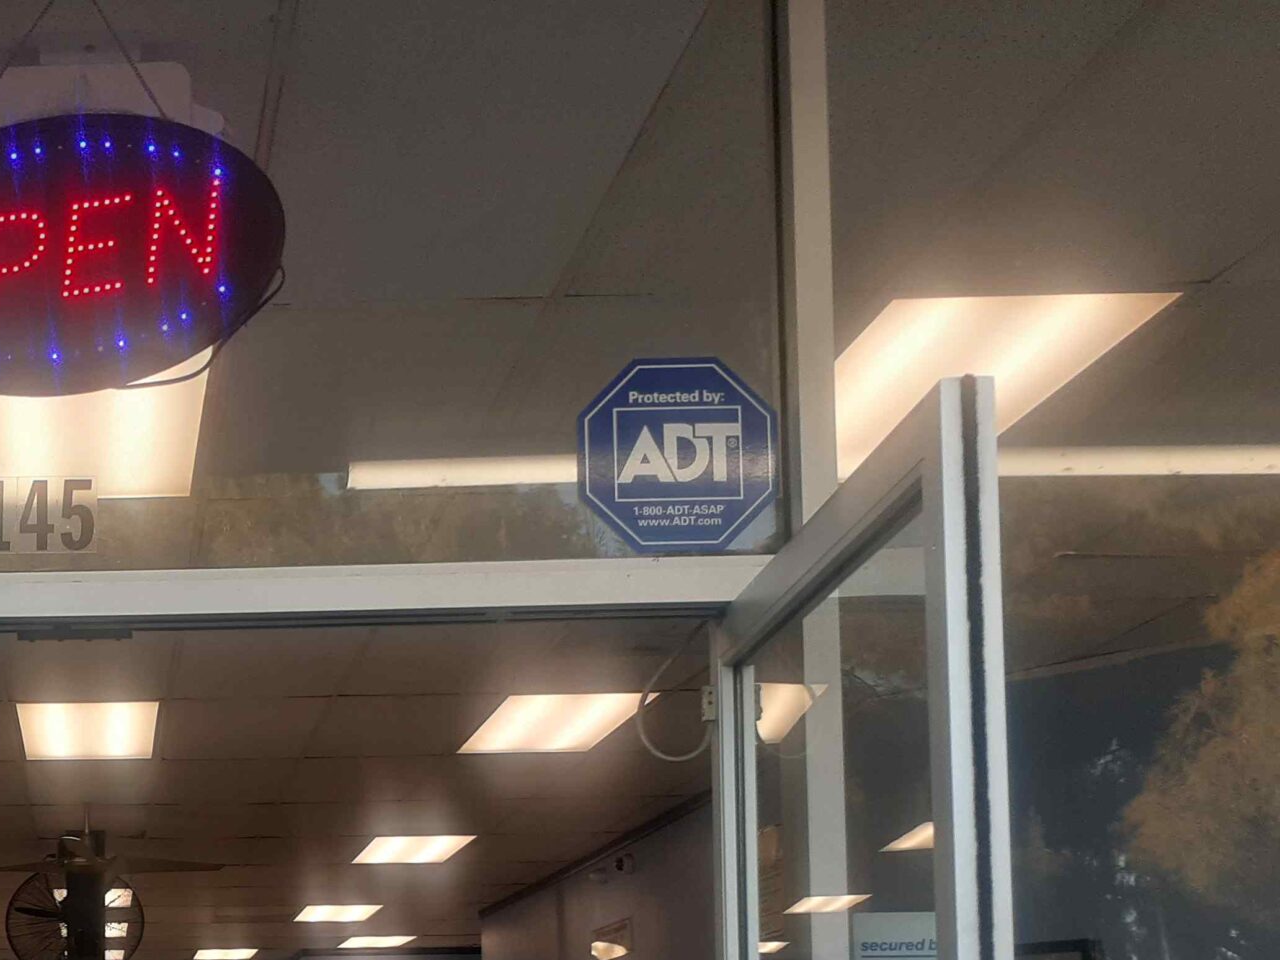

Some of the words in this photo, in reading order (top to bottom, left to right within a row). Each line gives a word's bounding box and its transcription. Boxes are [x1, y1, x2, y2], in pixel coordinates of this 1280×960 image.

[628, 391, 699, 404] Protected
[703, 390, 725, 404] by:
[617, 423, 740, 483] ADT
[633, 505, 725, 516] 1-800-ADT-ASAP
[637, 517, 722, 527] www.ADT.com
[860, 938, 925, 952] secured
